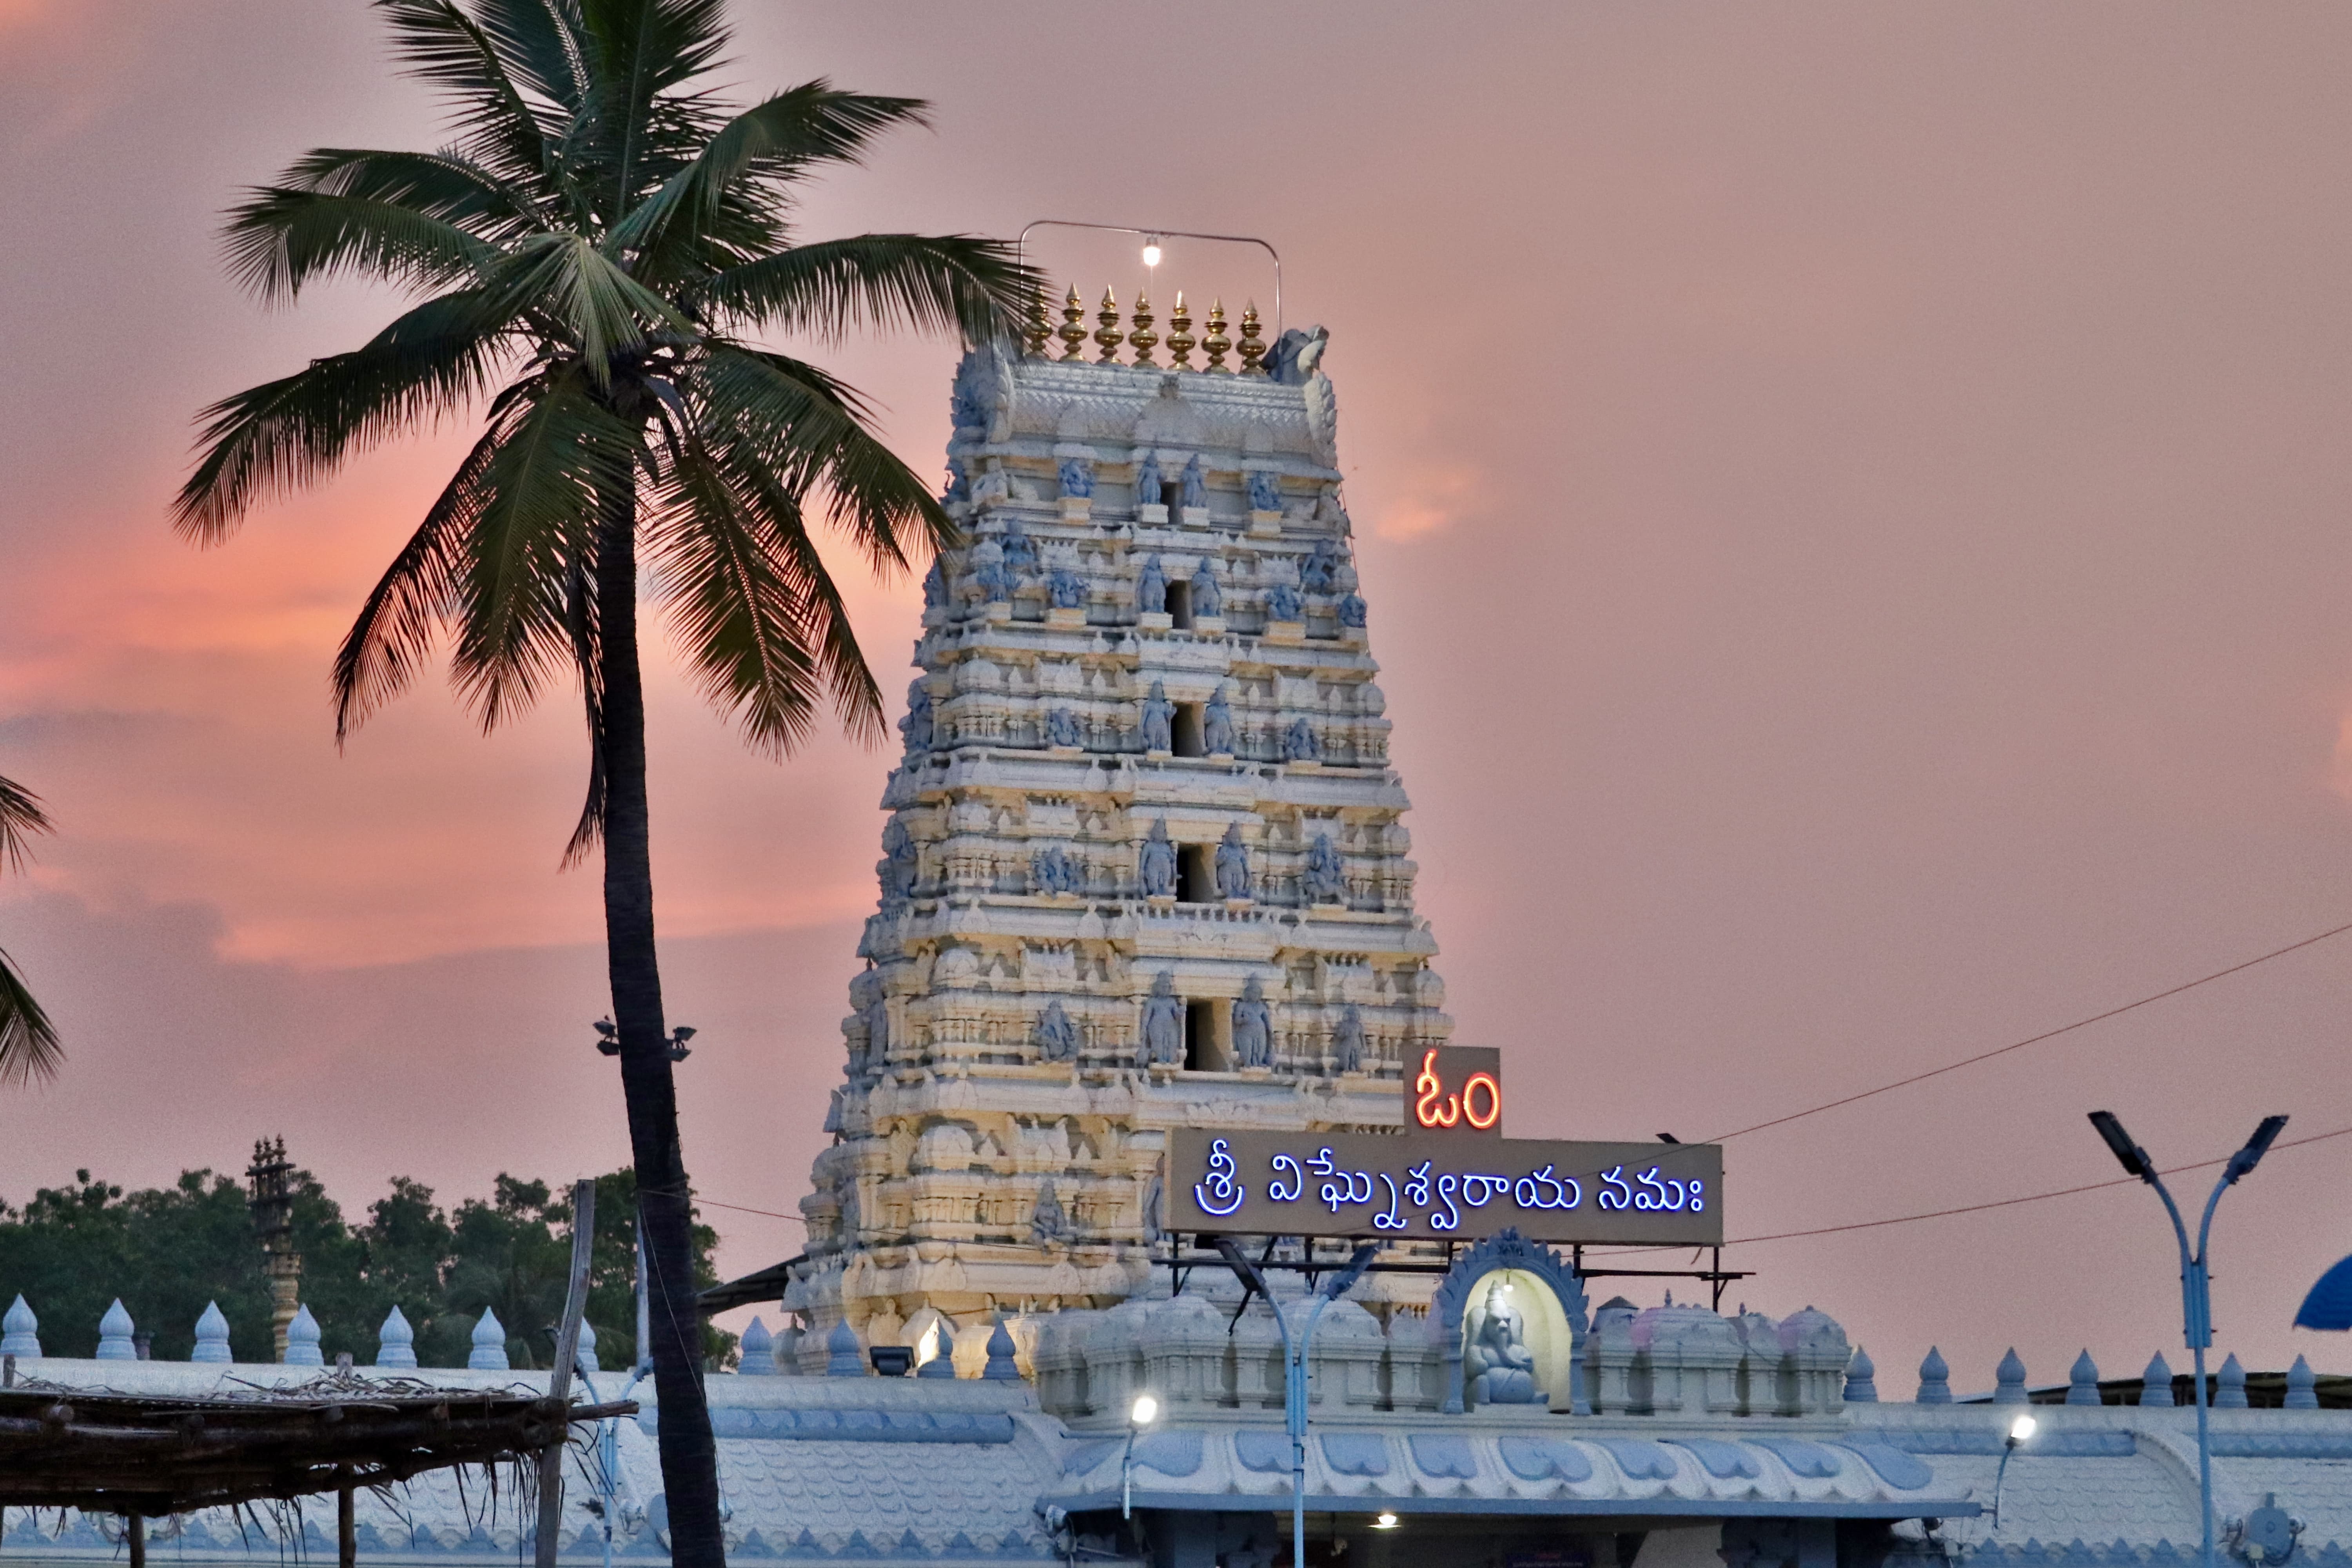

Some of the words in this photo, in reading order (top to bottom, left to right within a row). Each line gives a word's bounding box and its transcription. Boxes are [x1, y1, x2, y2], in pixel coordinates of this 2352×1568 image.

[1415, 1048, 1499, 1129] ఓం
[1194, 1138, 1246, 1216] శ్రీ
[1269, 1145, 1583, 1230] విఘ్నేశ్వరాయ
[1599, 1165, 1705, 1212] నమః
